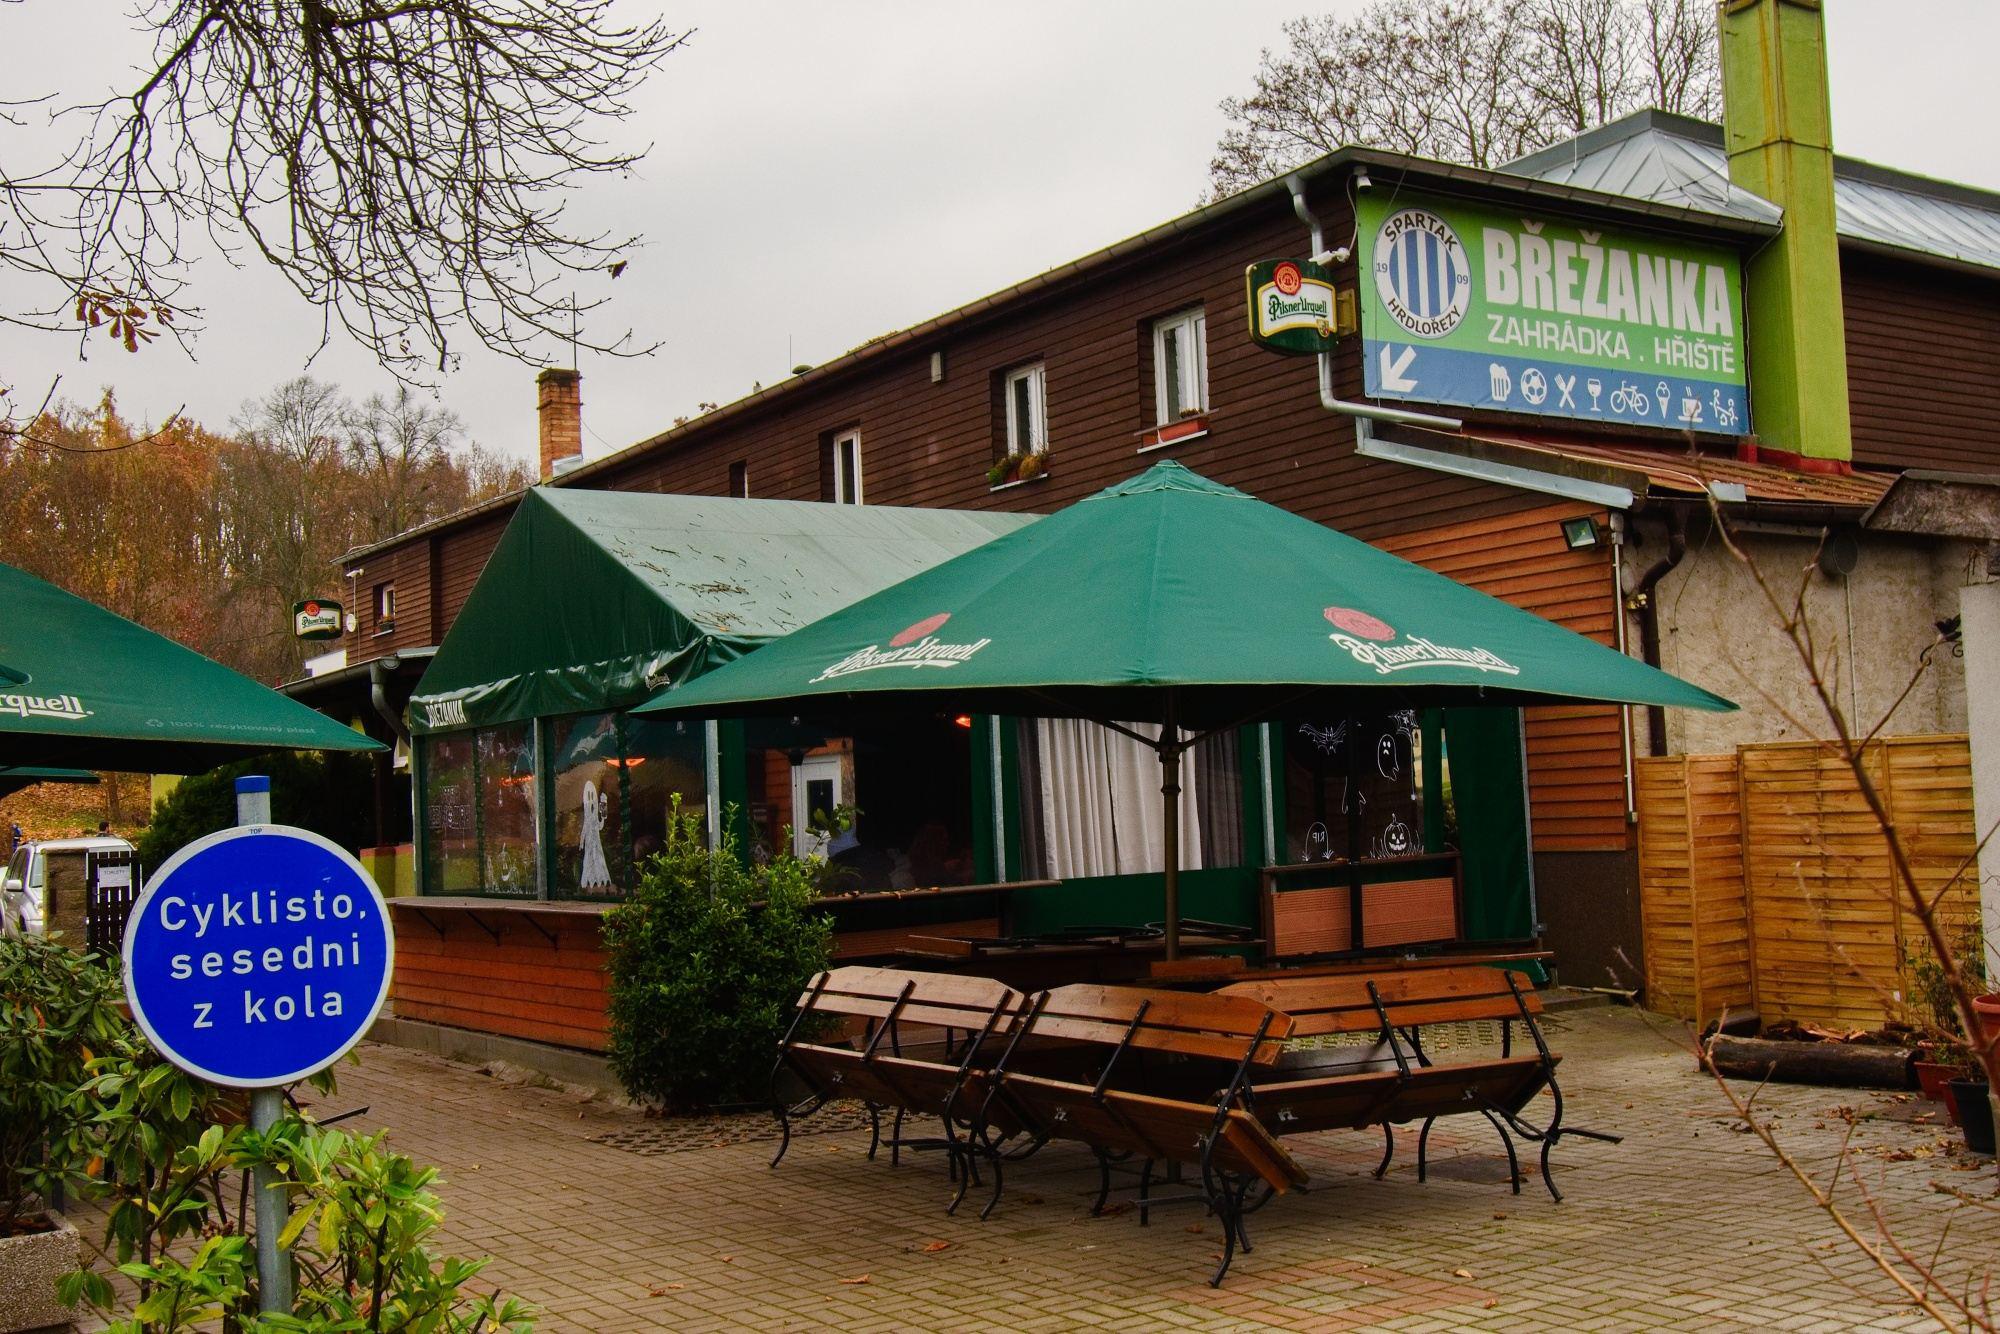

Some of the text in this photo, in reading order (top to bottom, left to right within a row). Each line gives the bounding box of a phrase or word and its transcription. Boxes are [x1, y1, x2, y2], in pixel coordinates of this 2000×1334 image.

[1385, 213, 1457, 252] SPARTAK
[1376, 262, 1388, 273] 19
[1456, 274, 1469, 285] 09
[1483, 218, 1734, 337] BŘEŽANKA
[1269, 294, 1327, 321] Pilsner Urquell
[1388, 298, 1461, 334] HRDLOŘEZY
[1487, 313, 1630, 360] ZAHRÁDKA
[1655, 335, 1736, 373] HŘIŠTĚ
[170, 721, 204, 729] 100%
[160, 889, 366, 938] Cyklisto,
[170, 932, 360, 980] sesedni
[193, 985, 343, 1029] z kola
